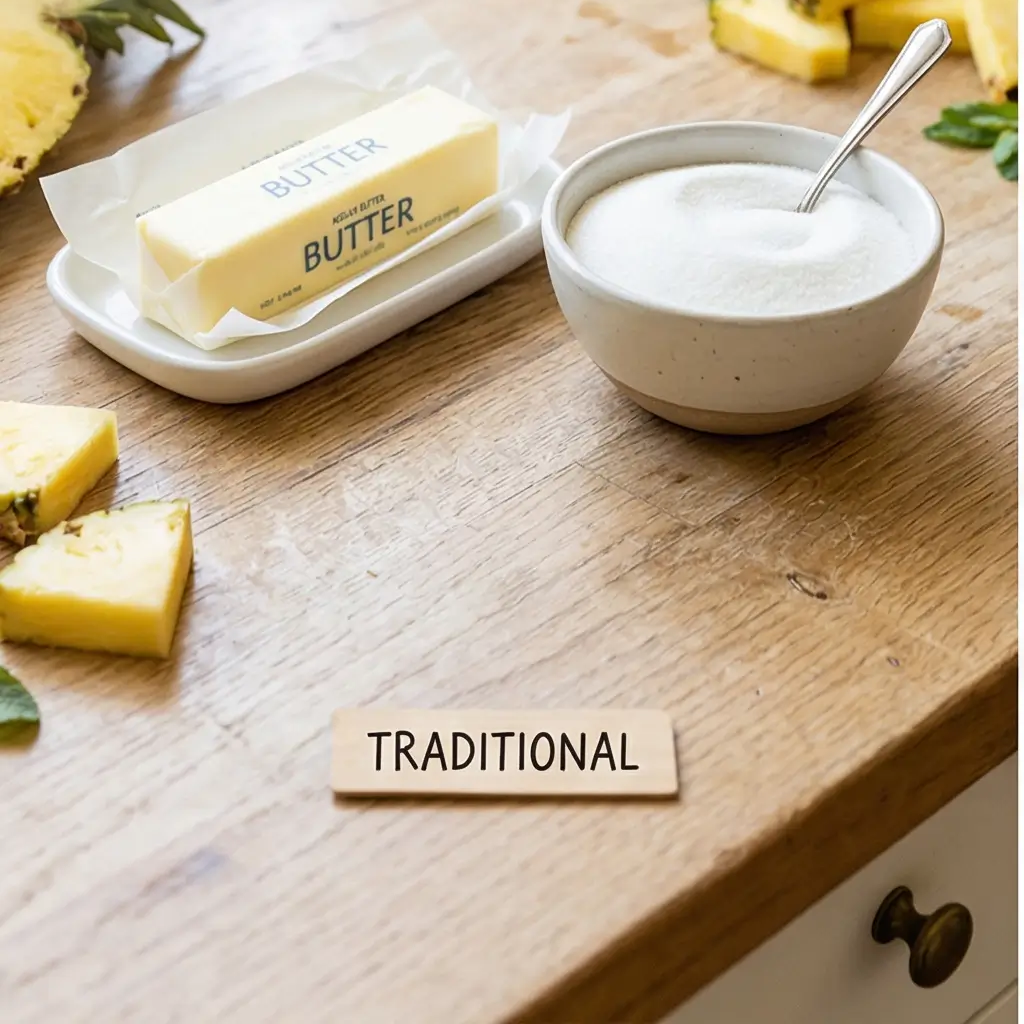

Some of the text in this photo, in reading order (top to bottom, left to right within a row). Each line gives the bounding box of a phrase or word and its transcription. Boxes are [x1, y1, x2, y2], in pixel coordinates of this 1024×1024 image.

[260, 137, 389, 198] BUTTER
[304, 196, 414, 273] BUTTER
[367, 731, 640, 771] TRADITIONAL
